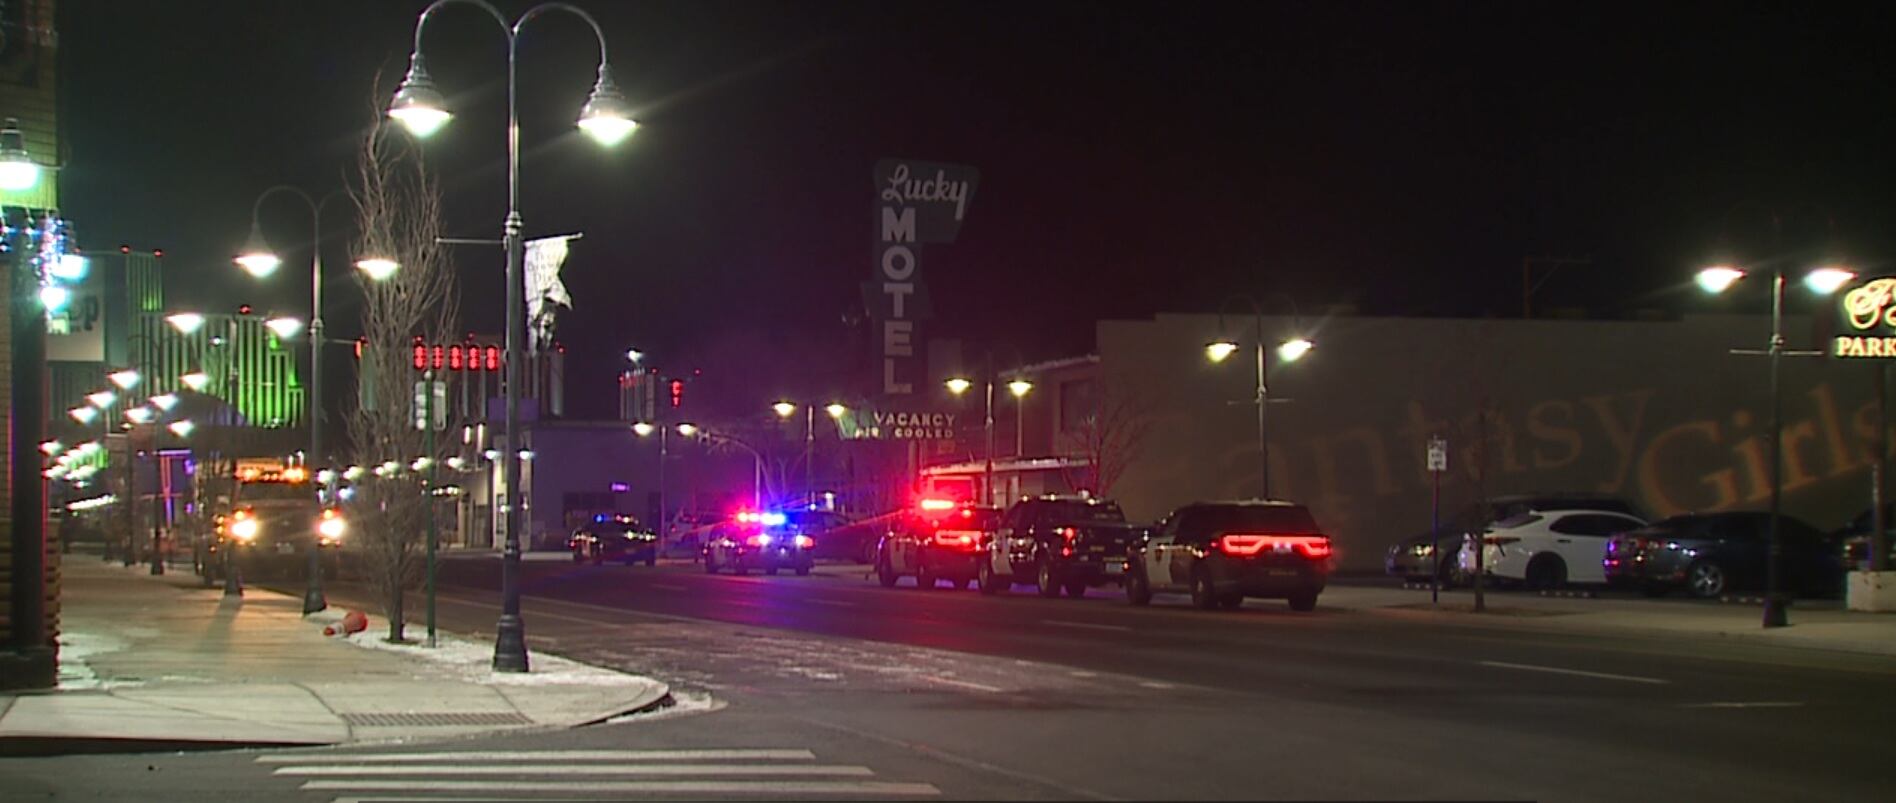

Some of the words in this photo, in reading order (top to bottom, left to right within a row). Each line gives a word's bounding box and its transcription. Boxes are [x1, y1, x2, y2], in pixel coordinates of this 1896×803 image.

[880, 163, 969, 221] Lucky
[881, 206, 917, 395] MOTEL
[873, 410, 956, 427] VACANCY
[894, 427, 955, 439] COOLED
